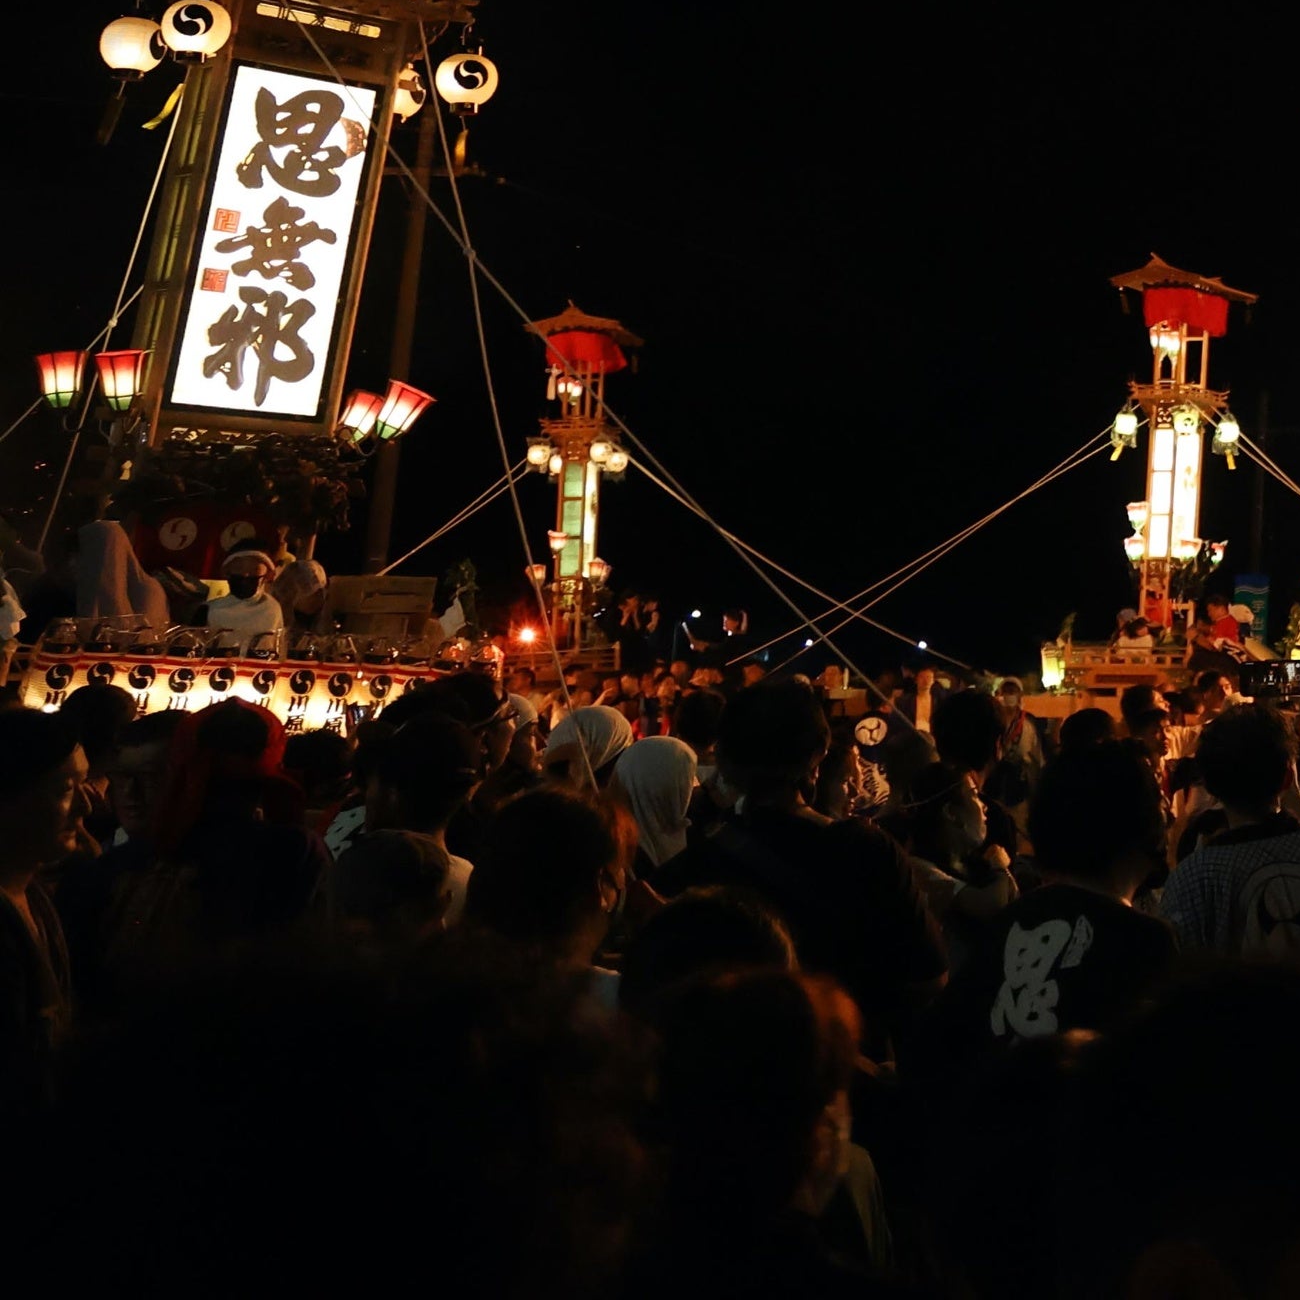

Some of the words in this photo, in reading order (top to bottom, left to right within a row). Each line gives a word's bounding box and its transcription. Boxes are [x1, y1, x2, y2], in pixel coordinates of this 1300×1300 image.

[203, 86, 346, 405] 思無邪
[284, 695, 309, 734] 川原
